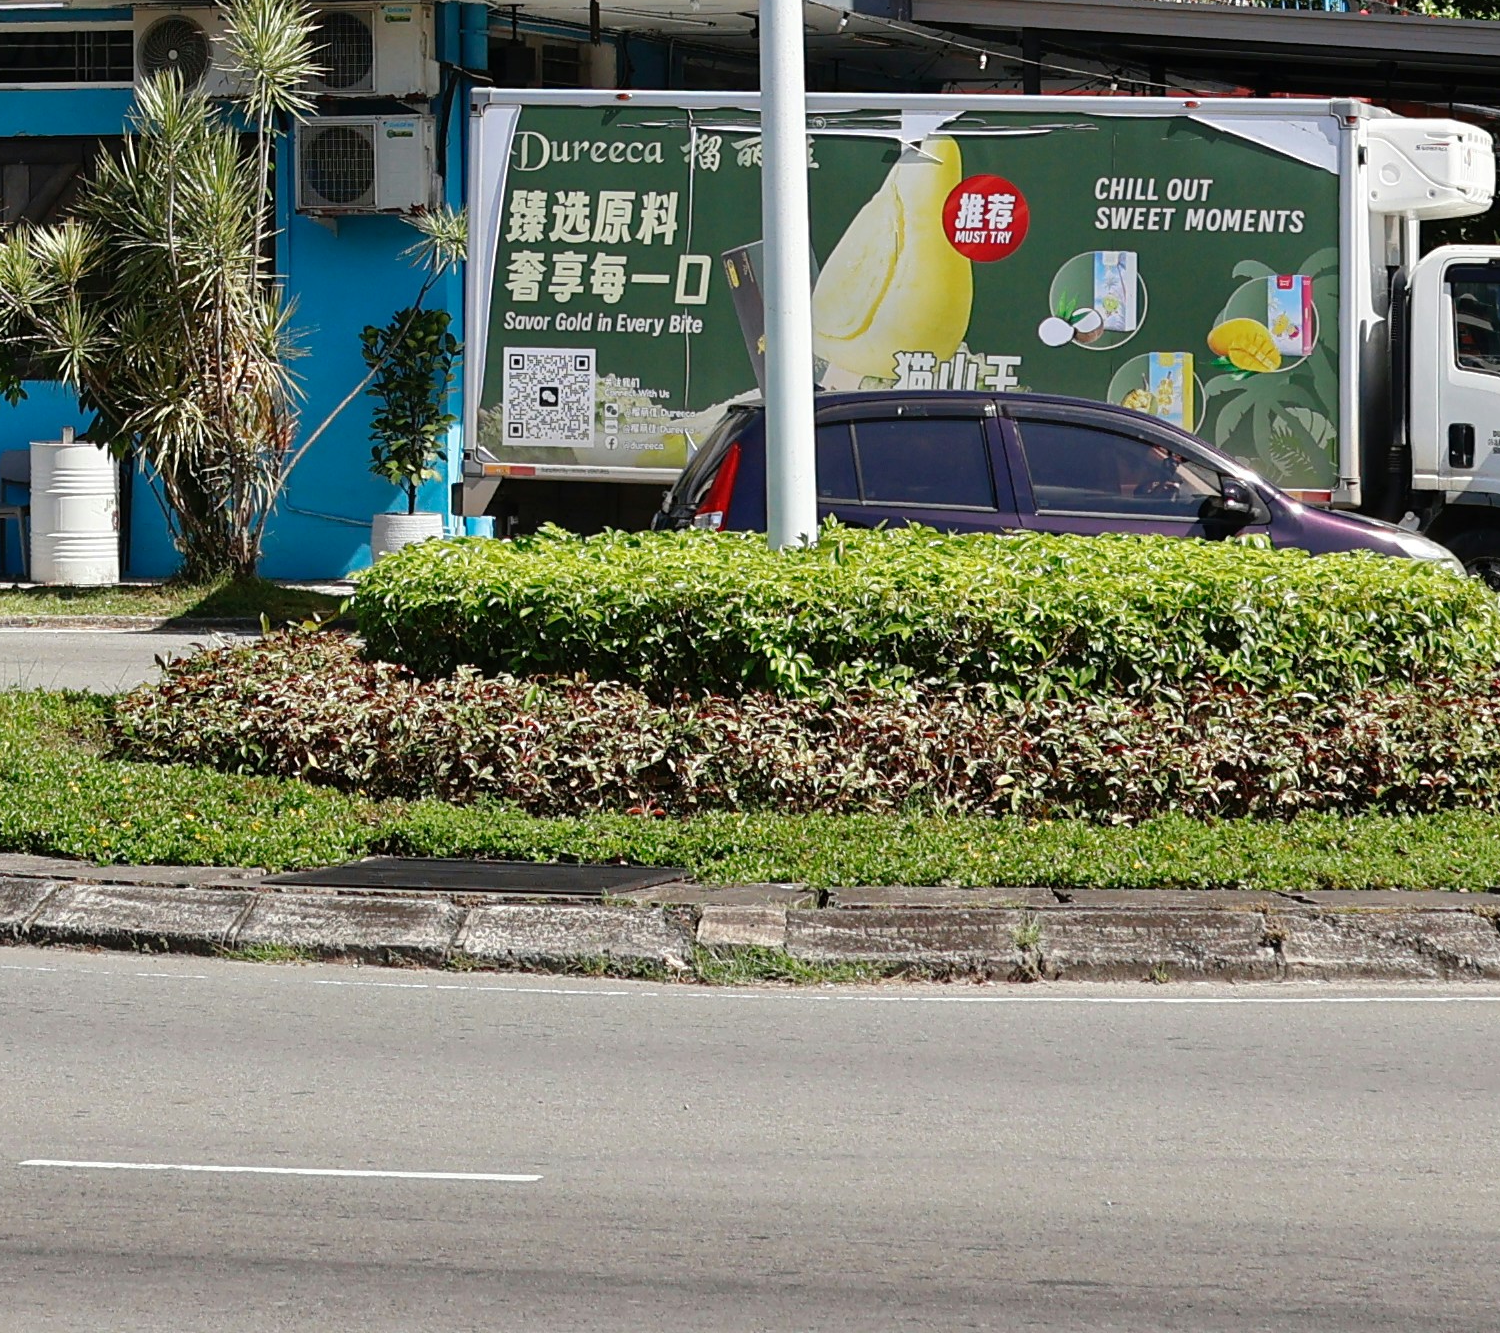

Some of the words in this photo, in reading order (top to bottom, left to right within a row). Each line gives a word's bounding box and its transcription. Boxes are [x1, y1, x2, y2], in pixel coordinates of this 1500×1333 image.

[511, 131, 664, 171] Dureeca
[1094, 177, 1160, 201] CHILL
[1166, 179, 1213, 202] OUT
[505, 190, 678, 245] 臻选原料
[954, 193, 1016, 230] 推荐
[1094, 207, 1176, 231] SWEET
[1184, 209, 1305, 233] MOMENTS
[954, 230, 988, 244] MUST
[989, 231, 1012, 245] TRY
[504, 249, 713, 305] 奢享每一口
[503, 311, 551, 331] Savor
[555, 312, 592, 331] Gold
[597, 312, 613, 332] in
[616, 313, 665, 337] Every
[669, 314, 703, 334] Bite
[893, 351, 1022, 391] 猫山王
